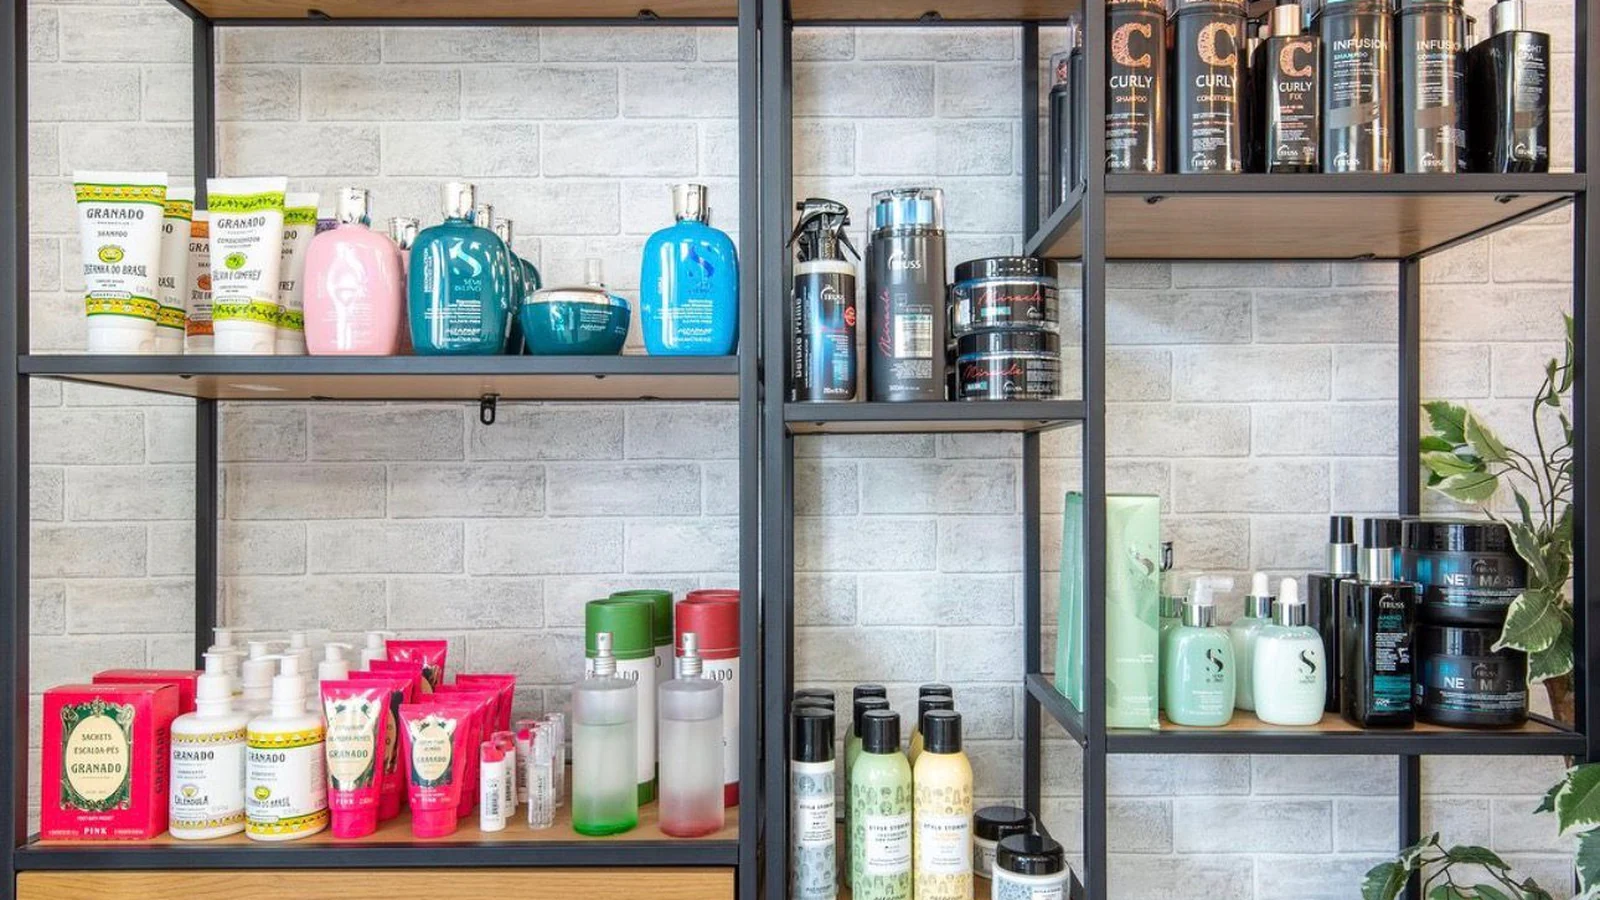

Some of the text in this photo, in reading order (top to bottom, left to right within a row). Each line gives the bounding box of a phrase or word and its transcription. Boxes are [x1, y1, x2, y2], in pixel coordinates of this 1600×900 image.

[1111, 22, 1152, 68] C
[1197, 21, 1237, 67] C
[1279, 40, 1313, 78] C
[1110, 76, 1154, 89] CURLY
[1279, 81, 1313, 93] CURLY
[1289, 92, 1304, 101] FIX
[87, 208, 145, 220] GRANADO
[217, 217, 266, 229] GRANADO
[82, 733, 112, 741] SACHETS
[71, 763, 122, 774] GRANADO
[84, 827, 107, 835] PINK
